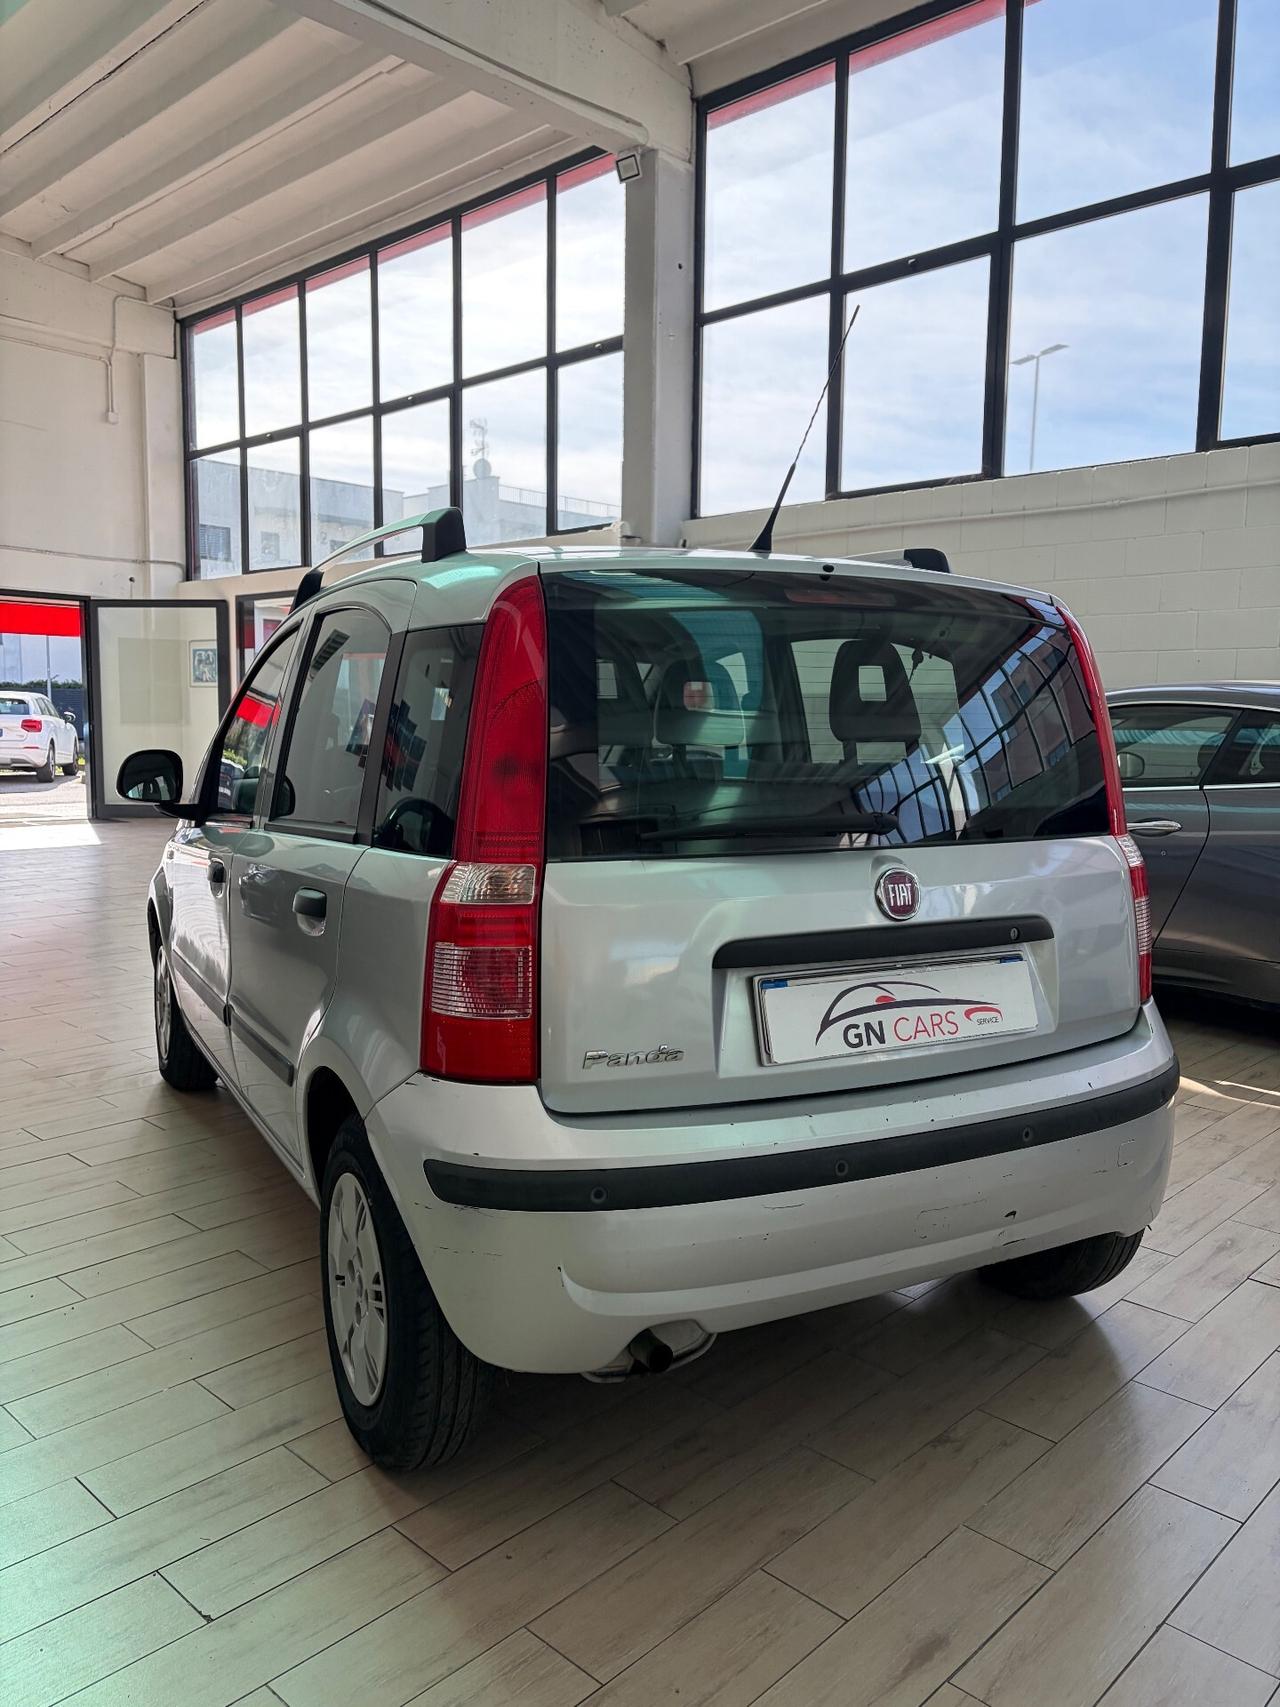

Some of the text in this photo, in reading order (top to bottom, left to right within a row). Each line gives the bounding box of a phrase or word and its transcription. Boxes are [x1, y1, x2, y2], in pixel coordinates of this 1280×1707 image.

[888, 883, 912, 907] FIAT
[842, 1010, 959, 1049] GN CARS
[976, 1016, 1000, 1026] SERVICE
[582, 1043, 685, 1070] Panda
